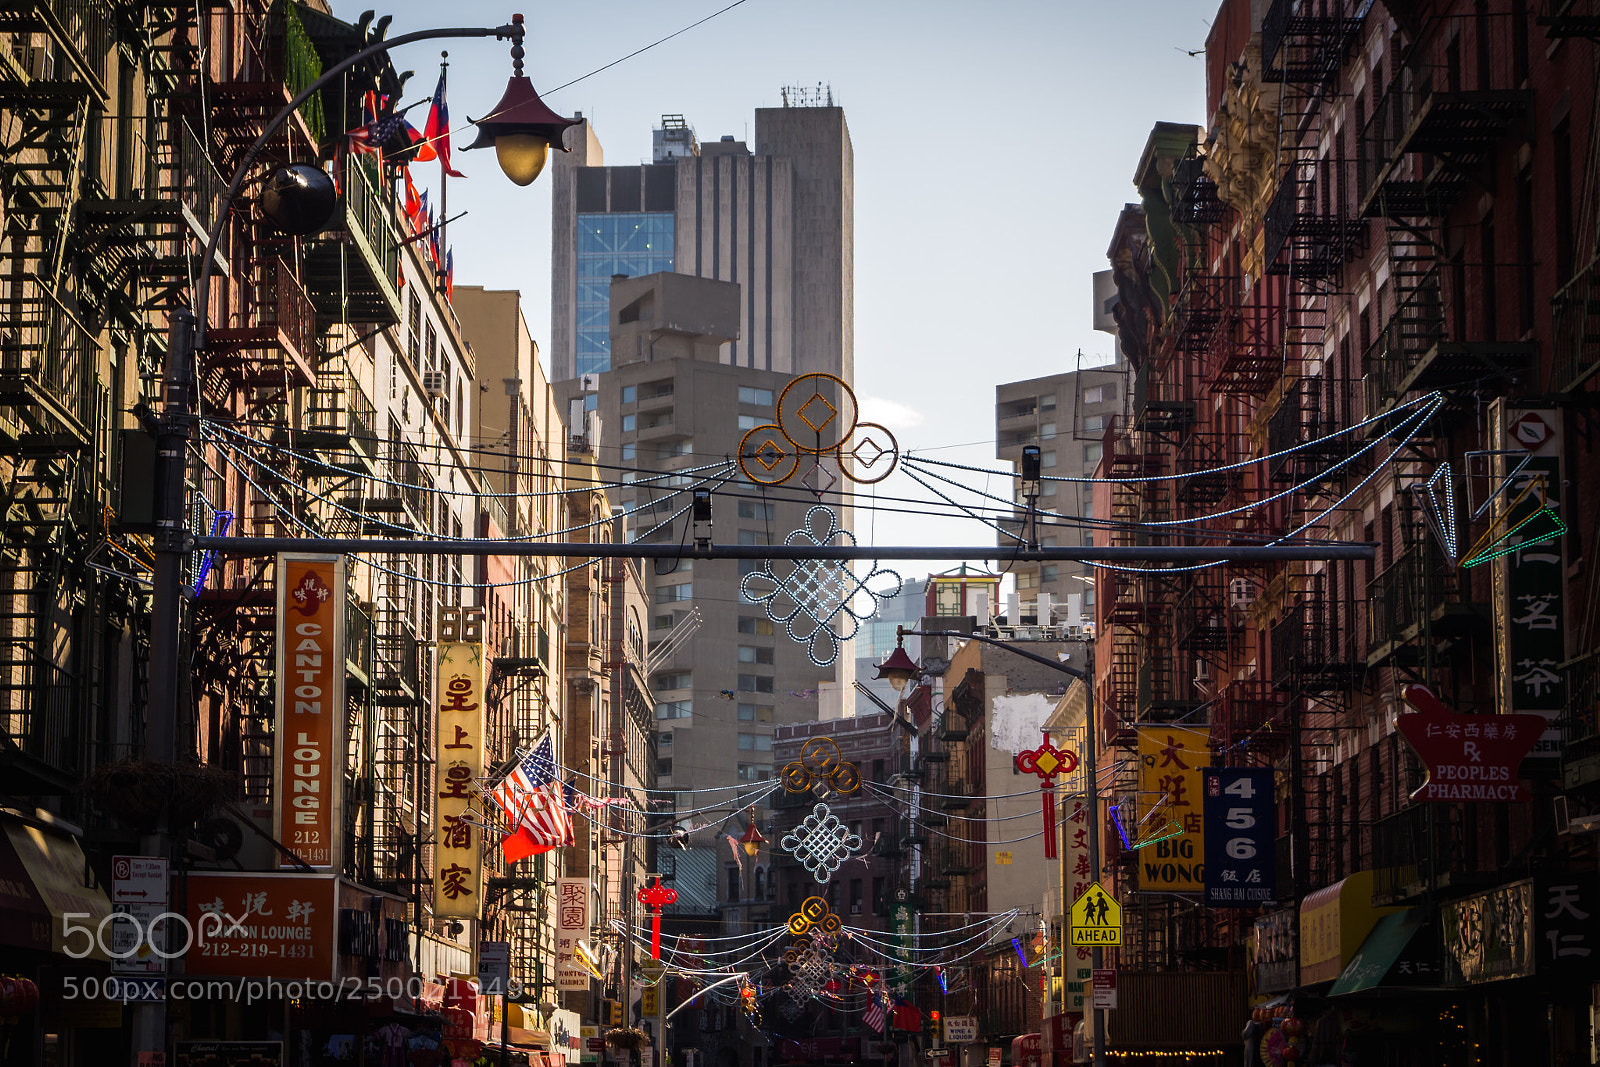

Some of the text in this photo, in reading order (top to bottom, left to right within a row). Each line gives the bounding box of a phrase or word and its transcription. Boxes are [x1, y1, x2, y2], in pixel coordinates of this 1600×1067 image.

[292, 622, 323, 825] CANTON LOUNGE
[1436, 765, 1510, 781] PEOPLES
[1427, 784, 1520, 801] PHARMACY
[1225, 777, 1256, 860] 456
[294, 831, 319, 844] 212
[1156, 839, 1193, 859] BIG
[206, 926, 311, 940] CANTON LOUNGE
[1076, 930, 1117, 941] AHEAD
[201, 943, 315, 959] 212-219-1431
